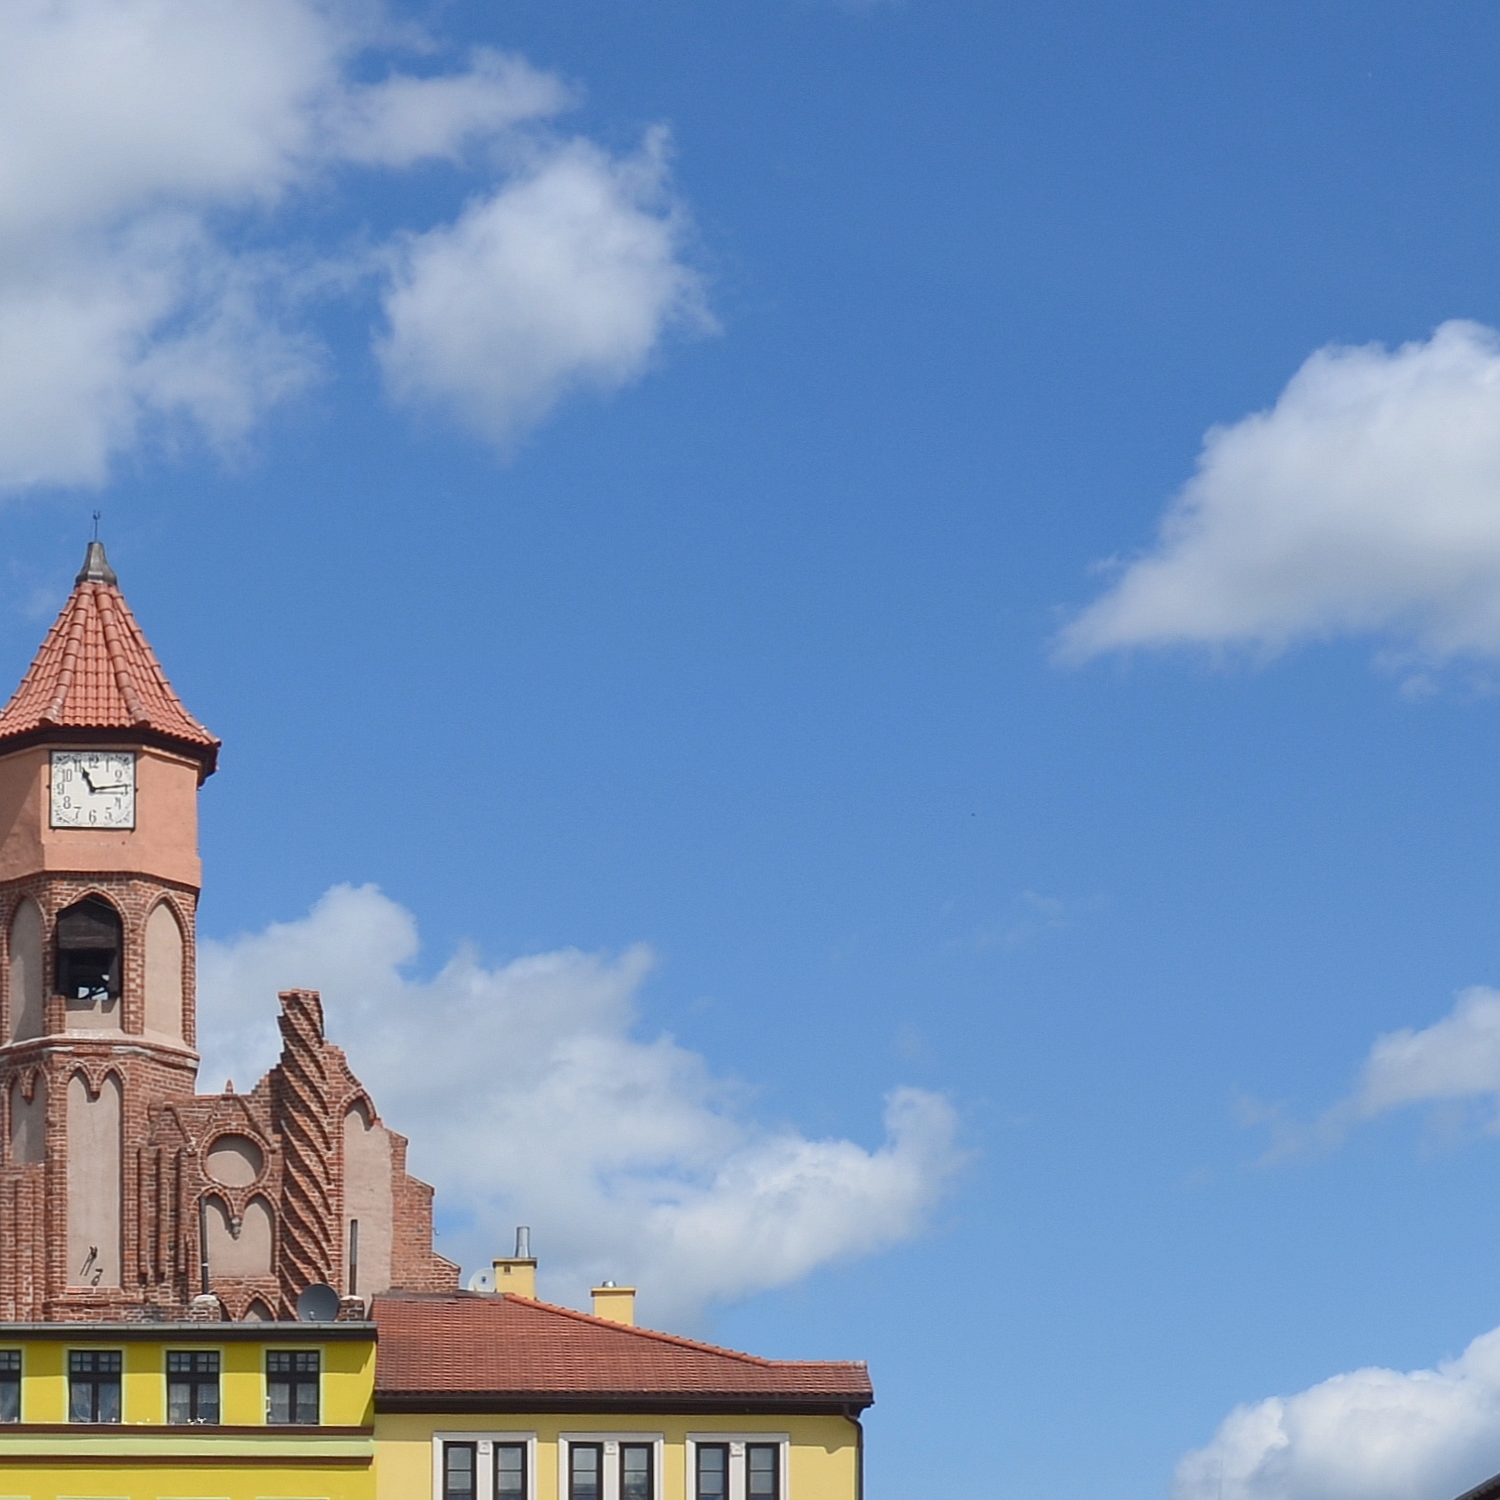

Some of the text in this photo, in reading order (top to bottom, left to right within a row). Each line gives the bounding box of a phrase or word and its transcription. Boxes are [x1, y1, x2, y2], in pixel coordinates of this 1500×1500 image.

[62, 768, 72, 782] 10
[114, 769, 123, 783] 2
[56, 782, 65, 795] 9
[63, 795, 71, 809] 8
[73, 805, 82, 820] 7
[88, 809, 97, 824] 6
[104, 806, 113, 821] 5
